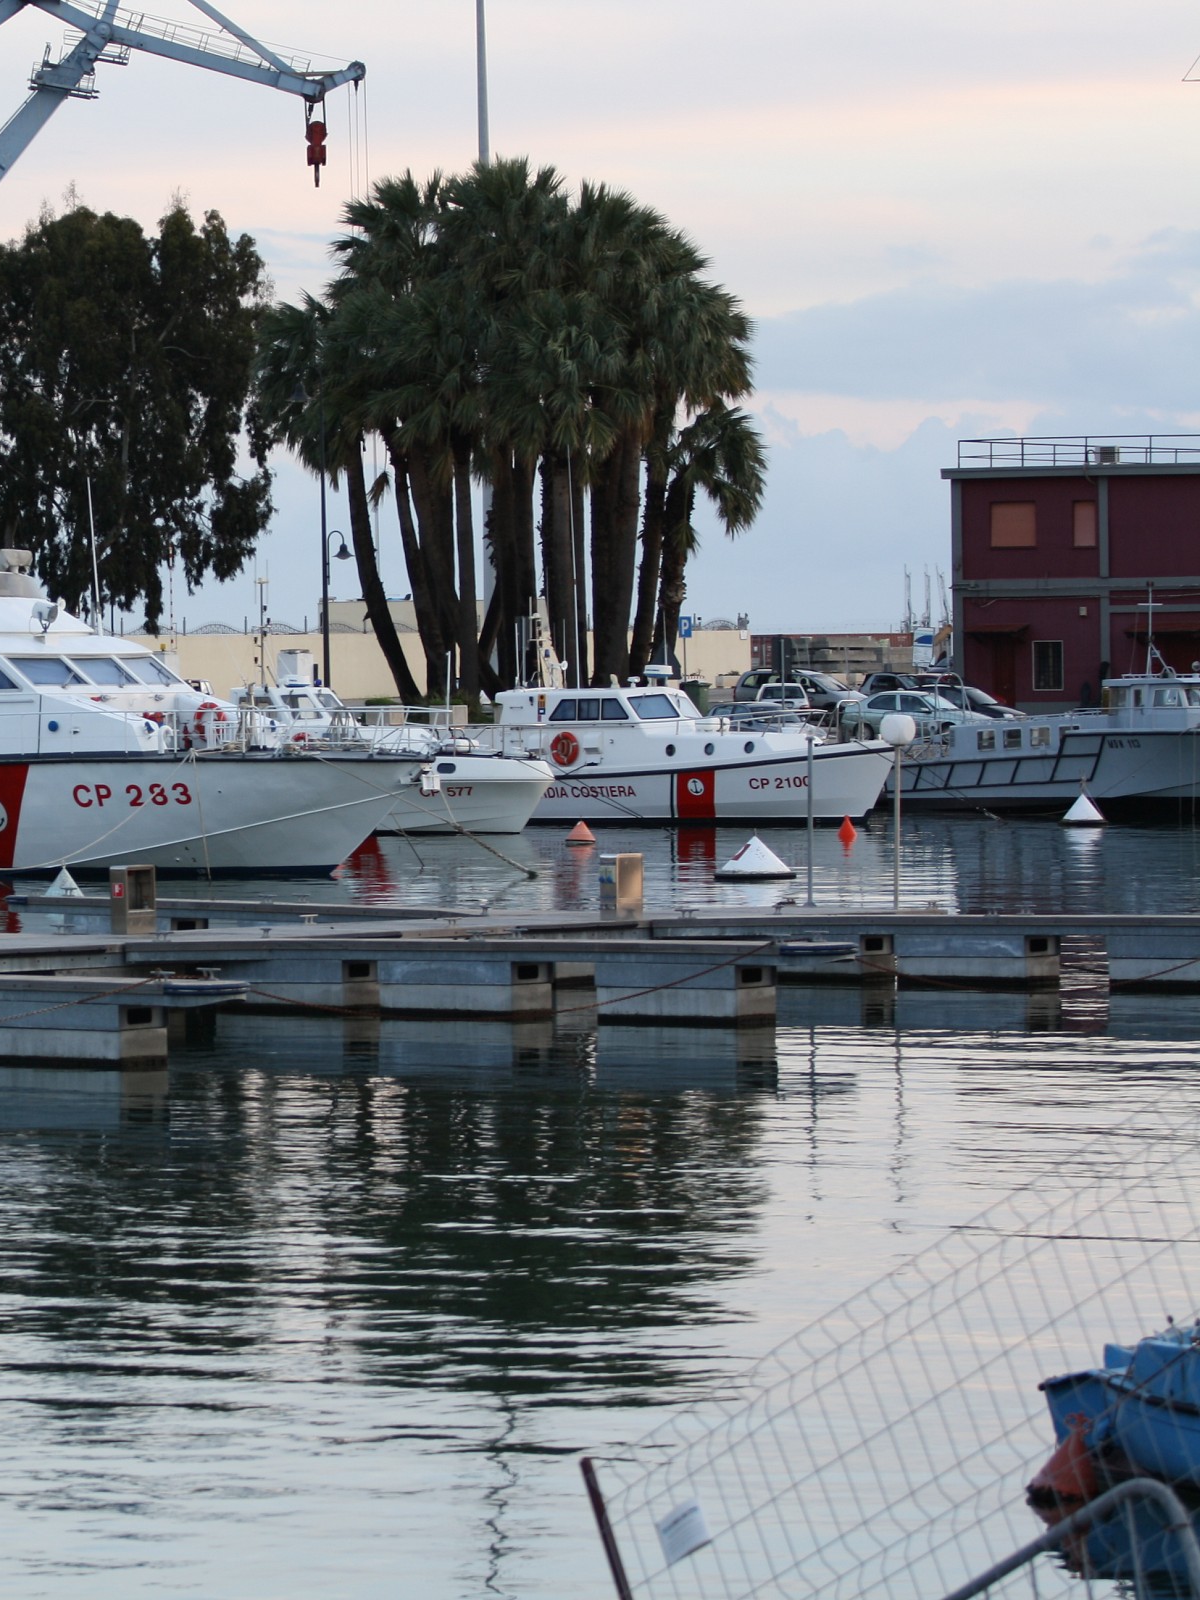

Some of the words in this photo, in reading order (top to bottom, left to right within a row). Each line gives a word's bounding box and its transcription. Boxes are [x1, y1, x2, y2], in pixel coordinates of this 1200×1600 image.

[681, 619, 689, 635] P
[749, 777, 770, 790] CP
[72, 784, 112, 808] CP
[125, 782, 193, 807] 283
[446, 785, 474, 798] 577
[570, 785, 637, 799] COSTIERA
